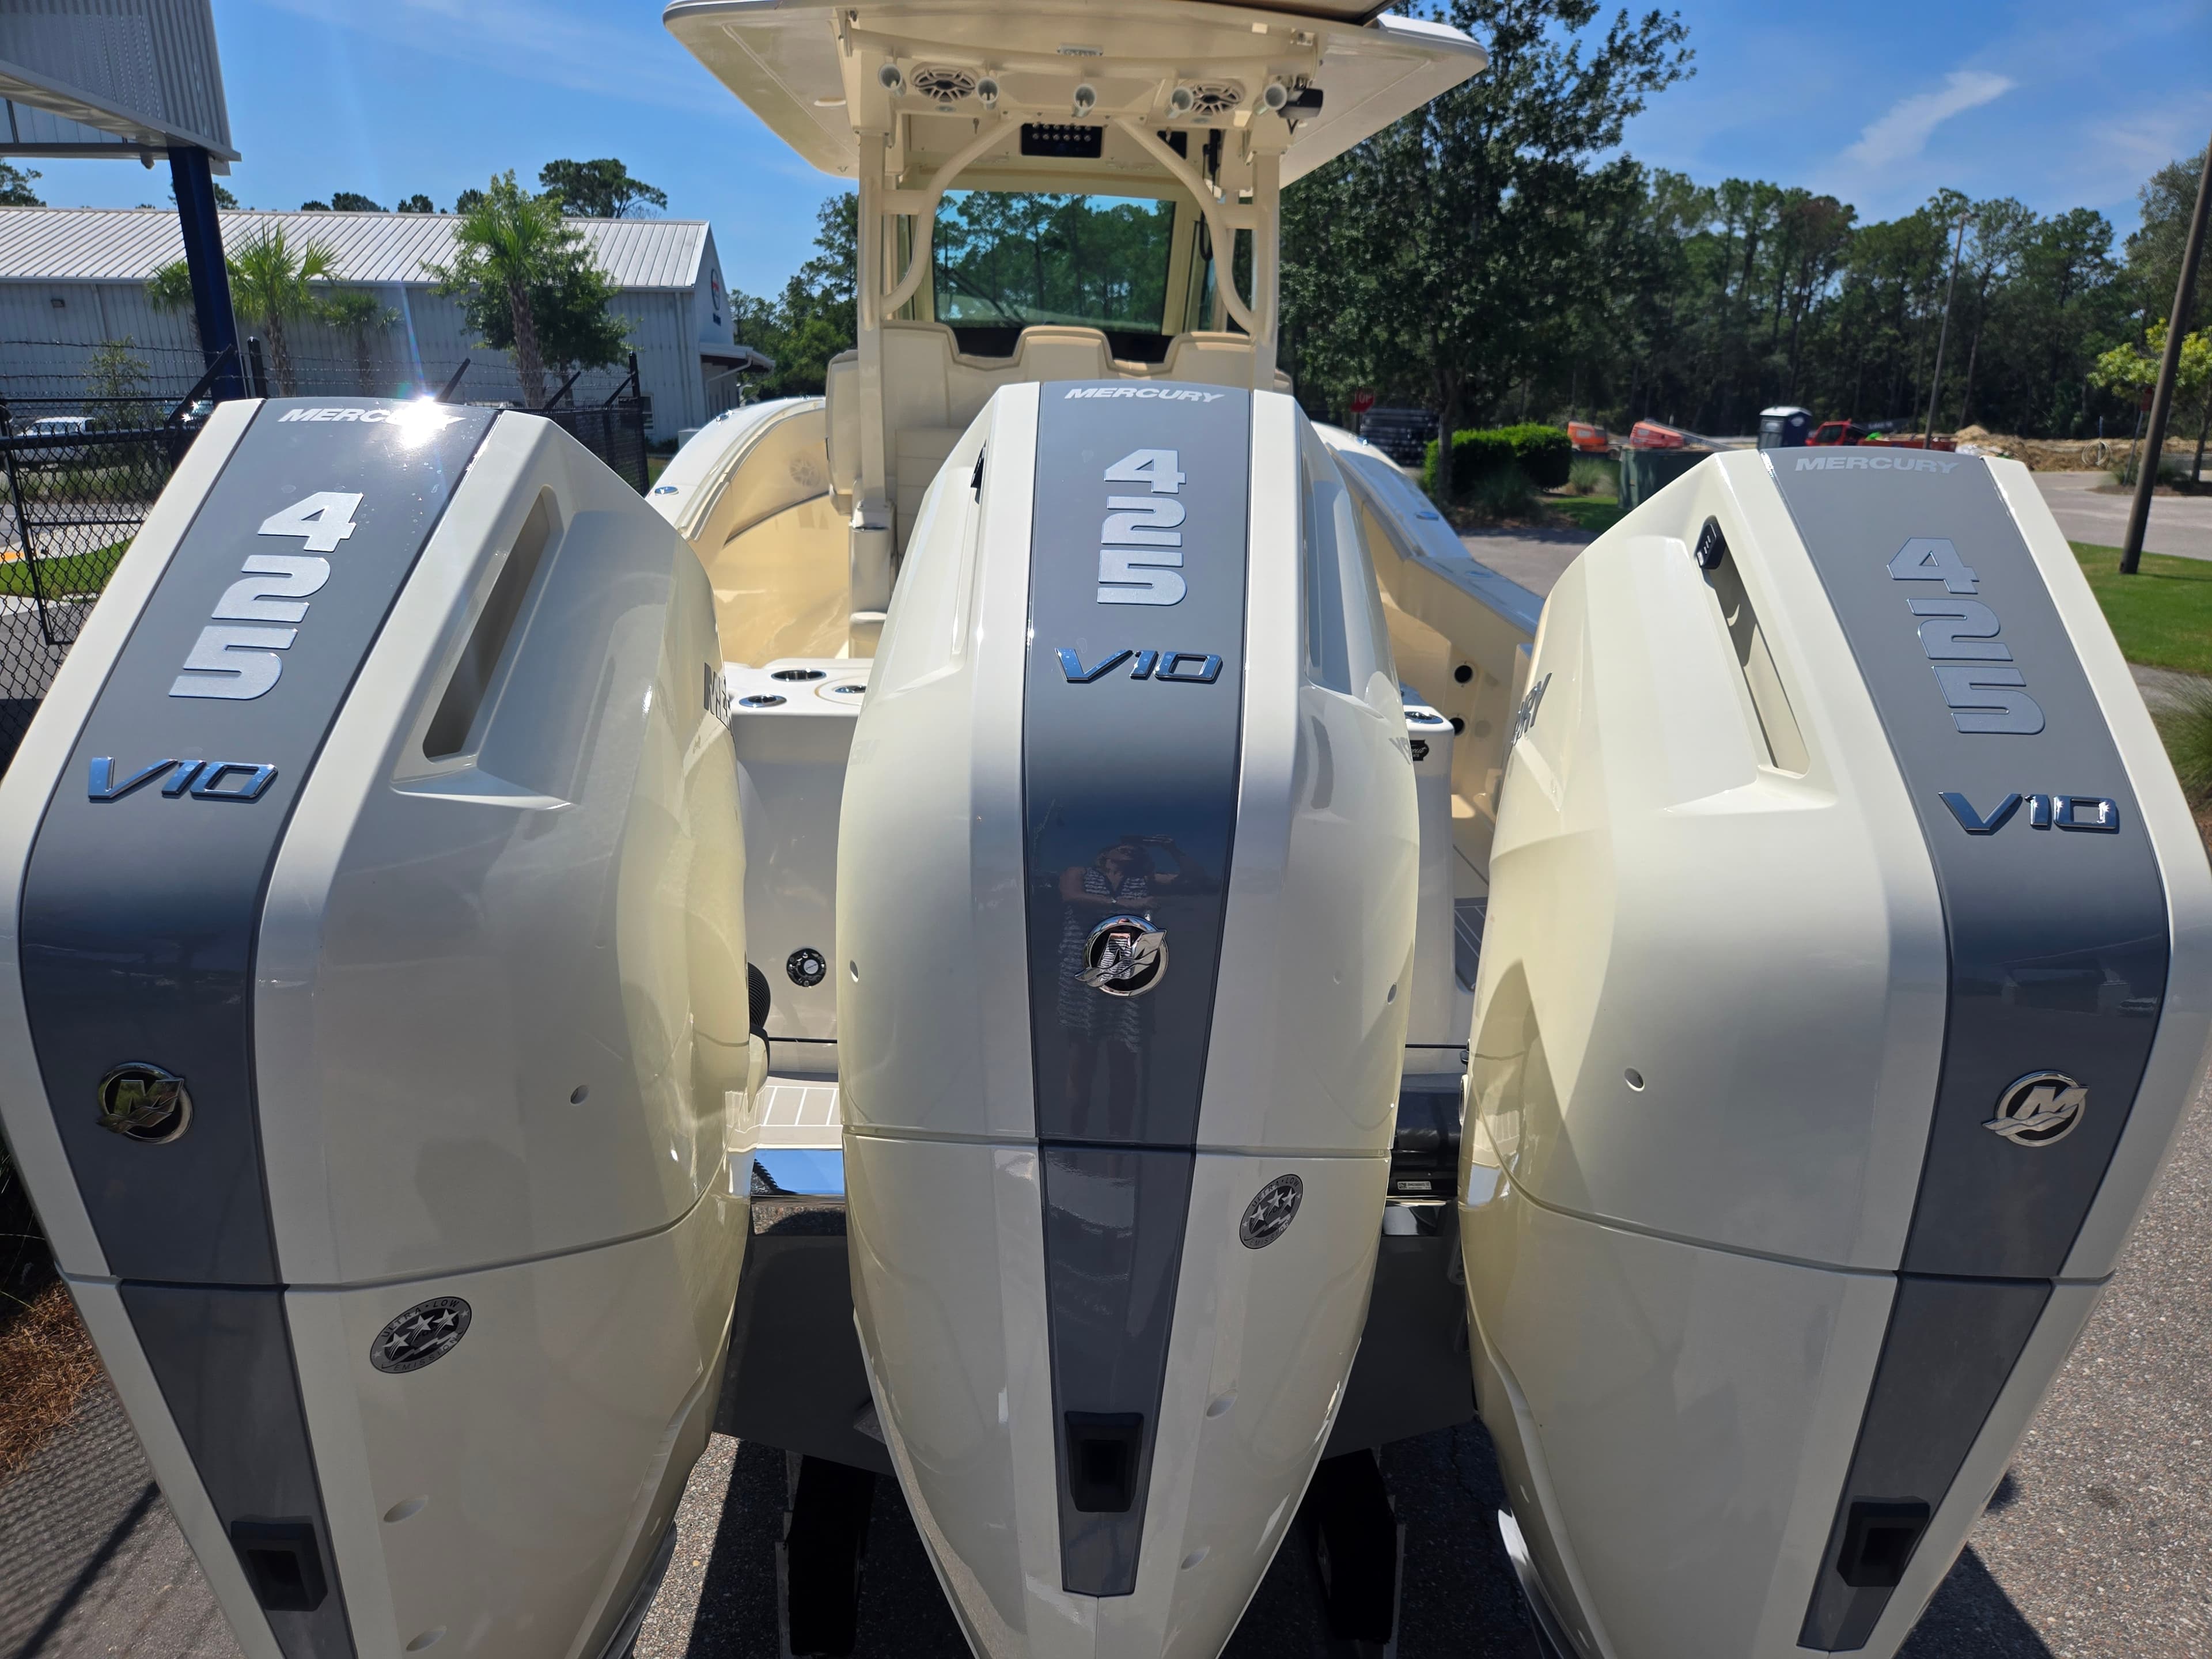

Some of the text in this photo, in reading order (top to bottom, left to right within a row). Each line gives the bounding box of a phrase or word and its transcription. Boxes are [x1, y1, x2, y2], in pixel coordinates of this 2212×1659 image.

[1065, 388, 1225, 403] MERCURY
[278, 408, 466, 423] MERC
[1795, 457, 1959, 474] MERCURY
[1096, 449, 1187, 606] 425
[168, 491, 364, 701] 425
[1887, 537, 2046, 735] 425
[1055, 647, 1224, 682] V10
[88, 757, 278, 798] V10
[1938, 792, 2118, 831] V10
[381, 1299, 460, 1338] ULTRA LOW
